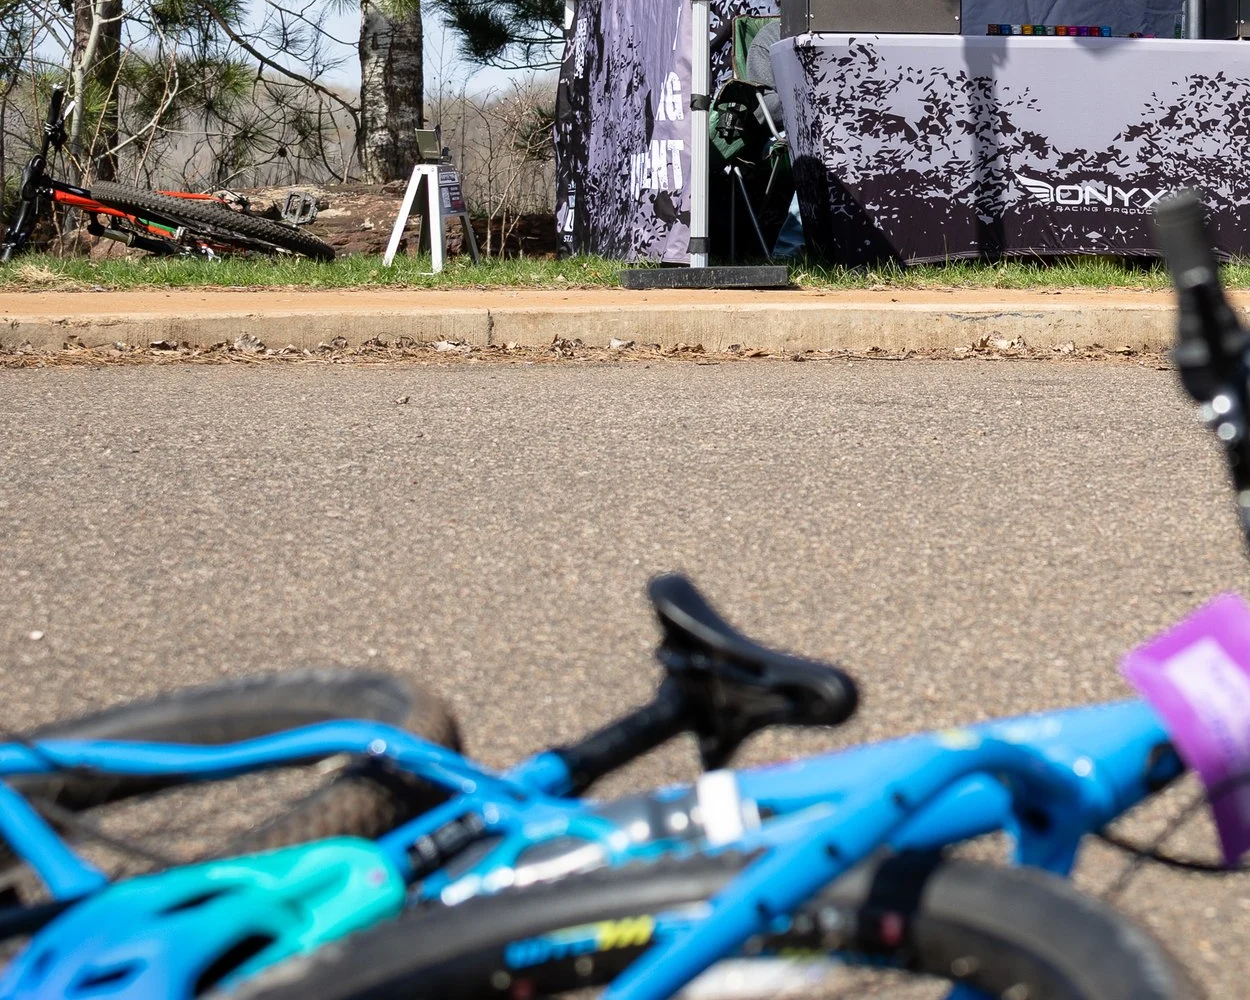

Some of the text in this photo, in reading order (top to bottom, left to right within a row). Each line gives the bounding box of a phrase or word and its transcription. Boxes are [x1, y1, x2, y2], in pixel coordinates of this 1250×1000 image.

[1055, 184, 1168, 208] ONYX
[1056, 205, 1153, 215] RACING PRODUC
